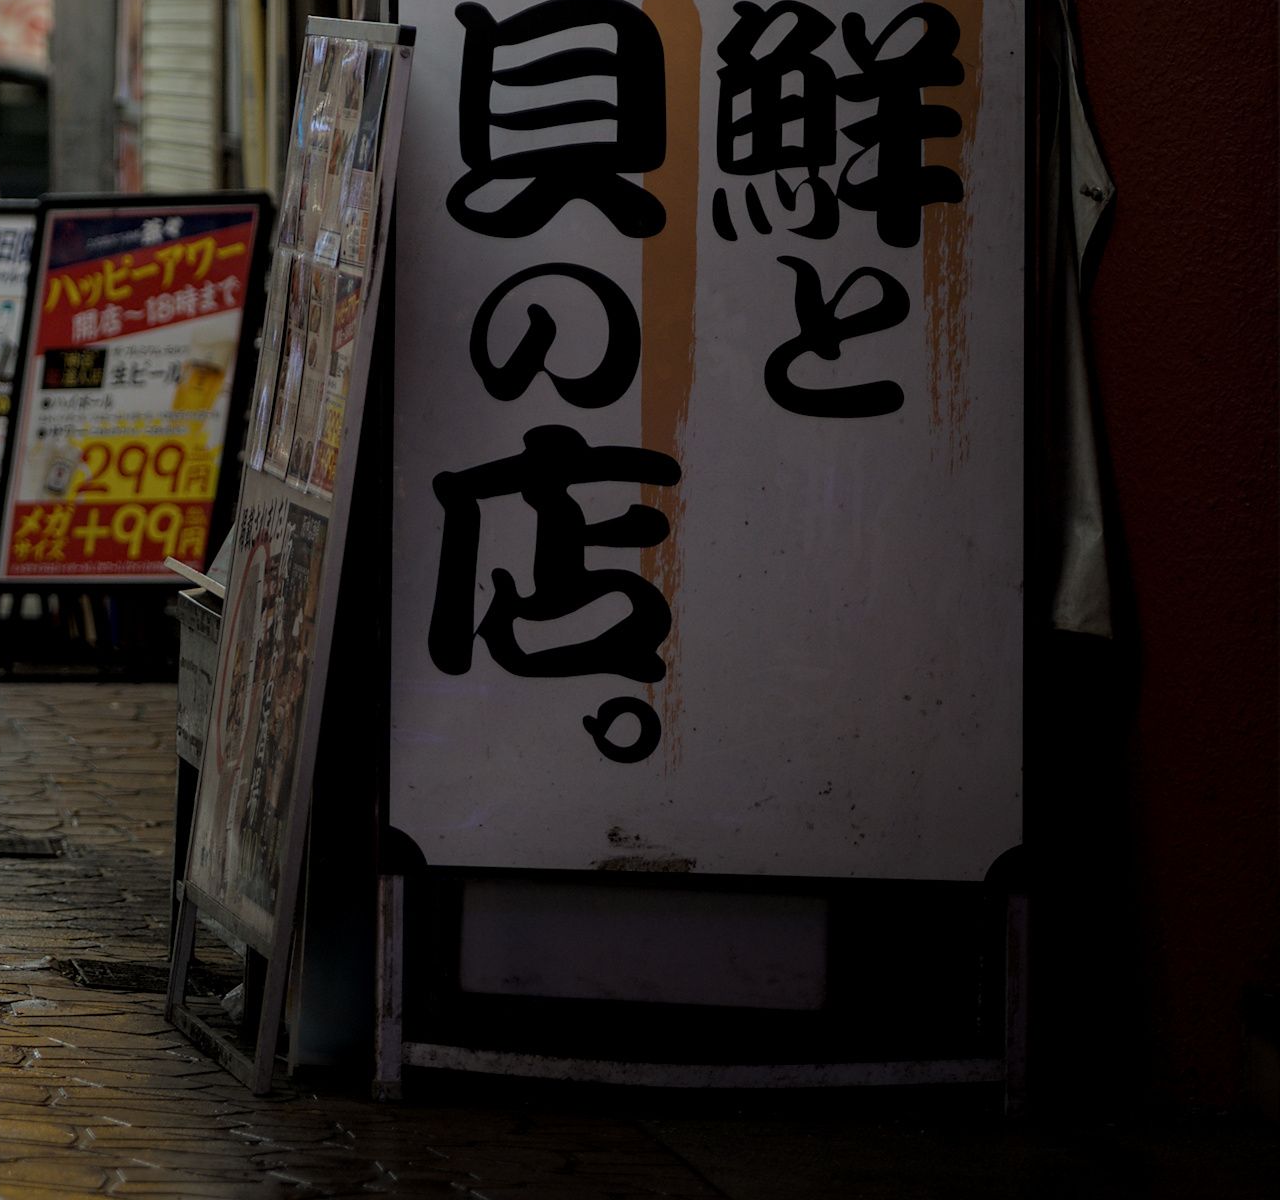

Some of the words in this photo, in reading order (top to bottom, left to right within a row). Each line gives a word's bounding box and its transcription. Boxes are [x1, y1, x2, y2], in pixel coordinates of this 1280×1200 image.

[43, 236, 246, 314] ハッピーアワー
